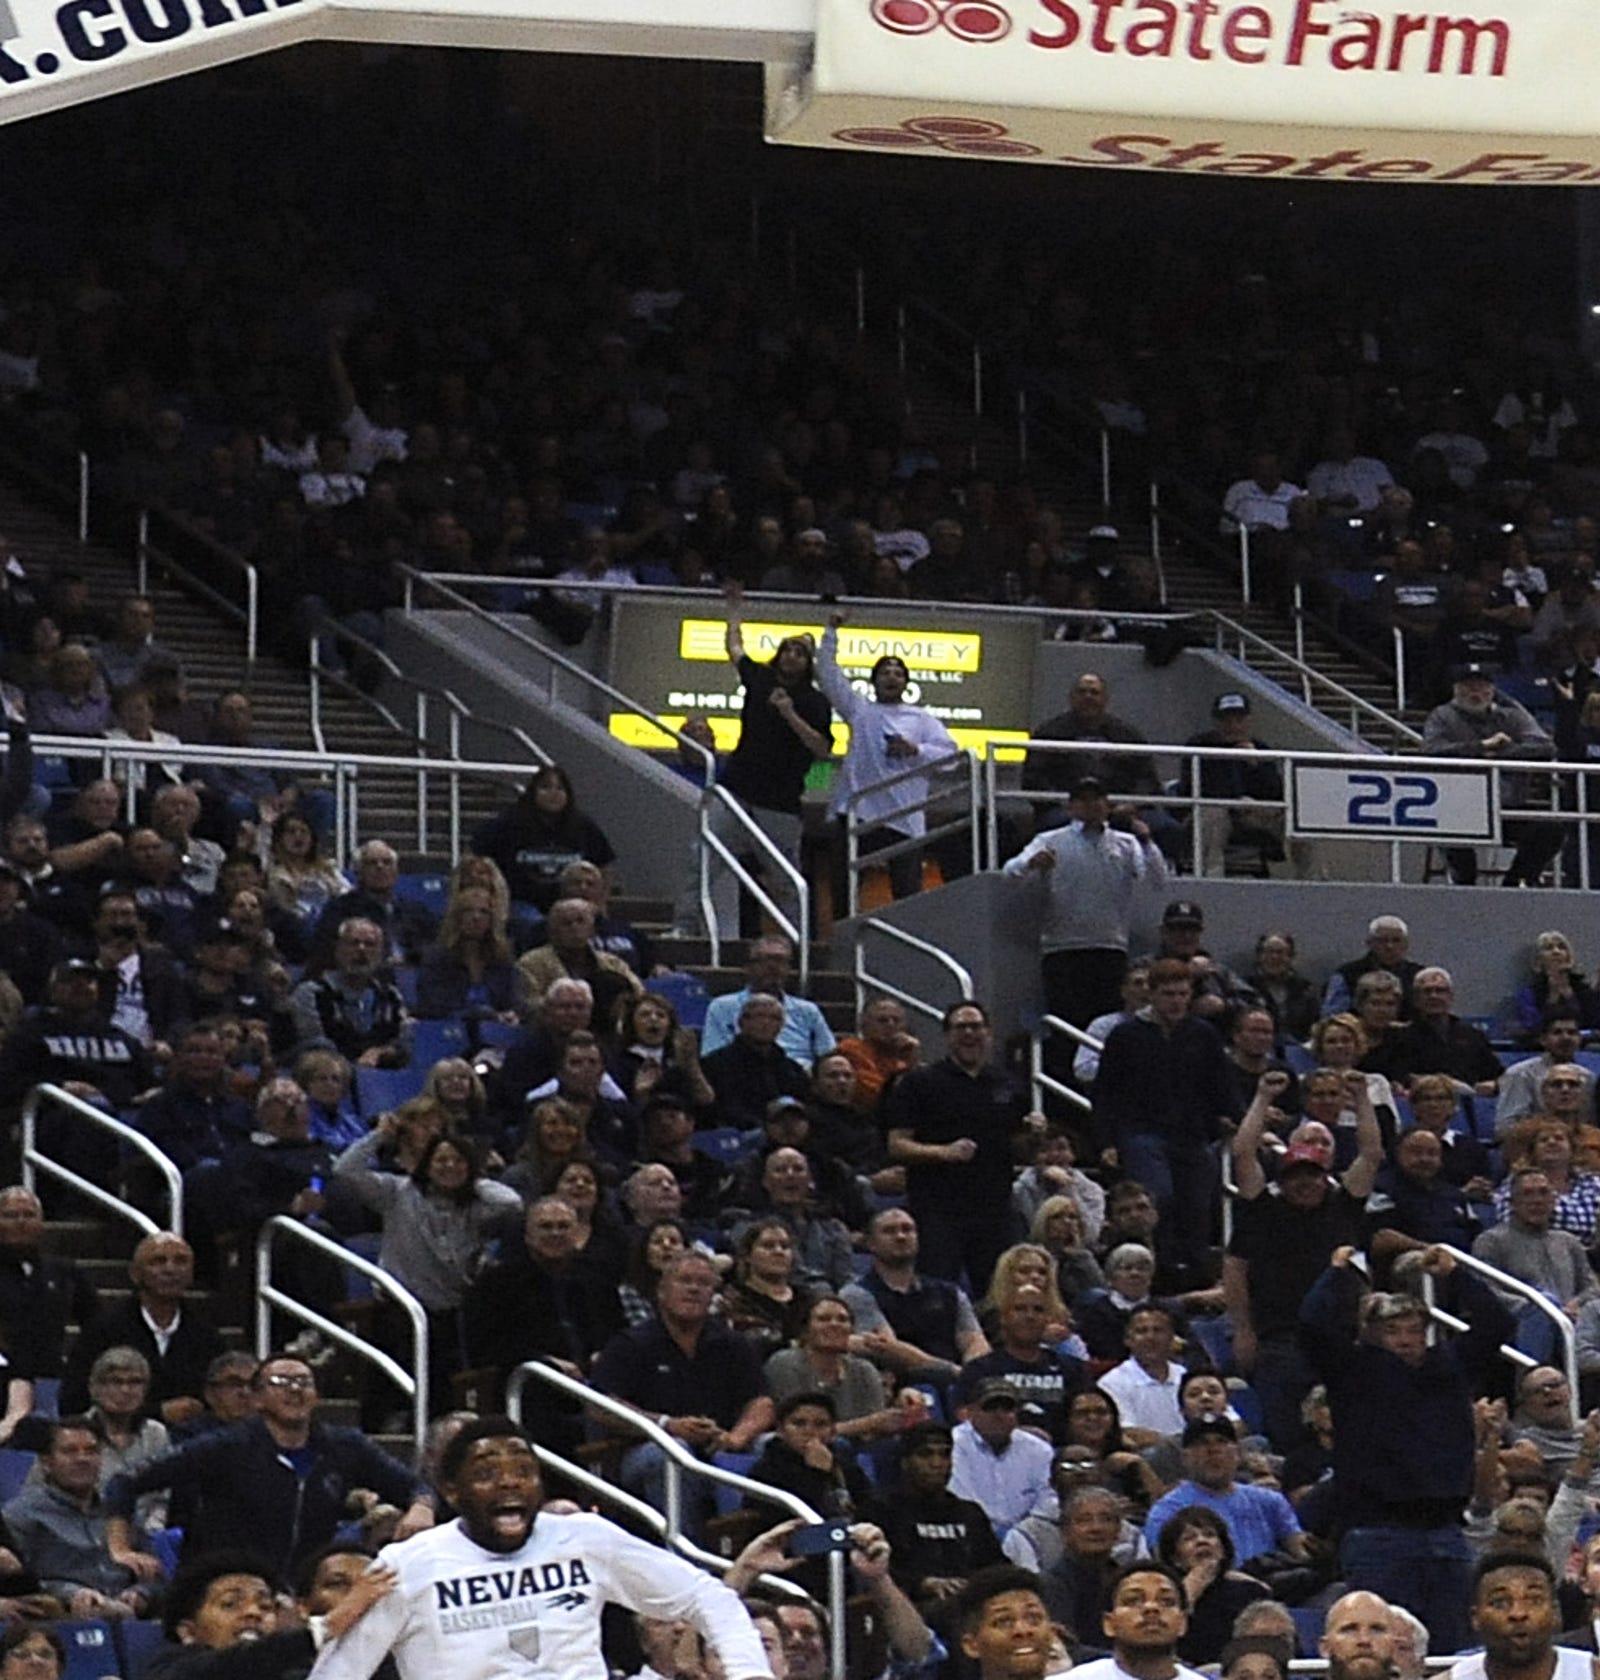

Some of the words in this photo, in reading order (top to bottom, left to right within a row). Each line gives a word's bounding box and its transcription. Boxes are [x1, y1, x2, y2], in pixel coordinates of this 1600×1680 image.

[1285, 0, 1510, 77] Farm
[1348, 774, 1438, 828] 22
[434, 1558, 592, 1610] NEVADA
[437, 1600, 539, 1635] BASKETBALL
